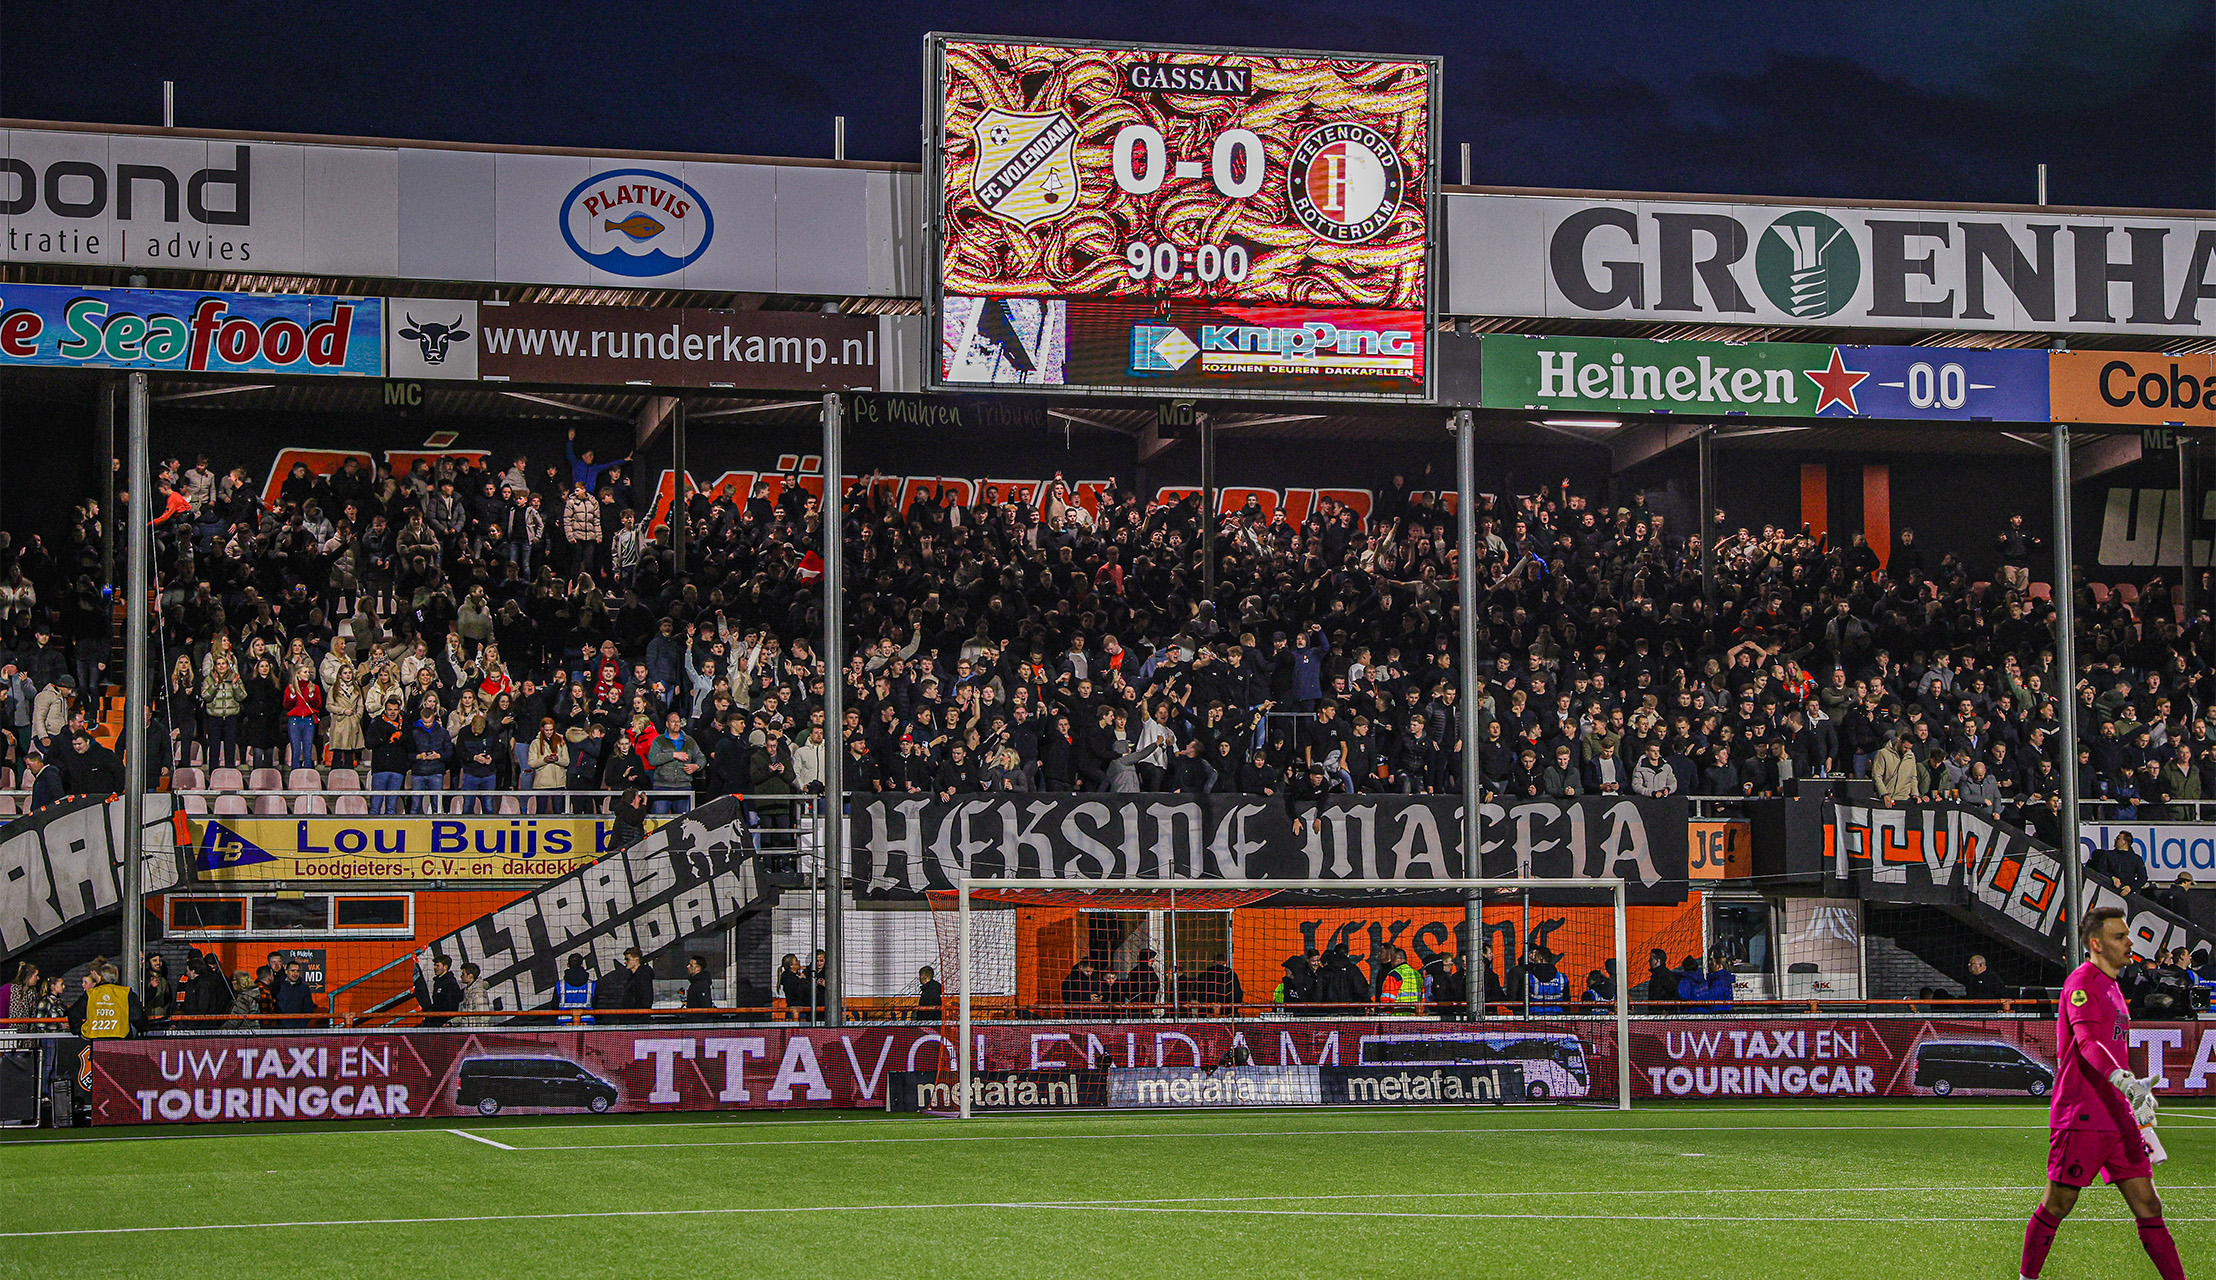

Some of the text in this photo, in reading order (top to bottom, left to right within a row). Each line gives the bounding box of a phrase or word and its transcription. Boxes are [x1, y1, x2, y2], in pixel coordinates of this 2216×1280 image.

[1131, 65, 1248, 92] GASSAN
[979, 118, 1073, 206] FC VOLENDAM
[1112, 125, 1265, 198] 0-0
[1297, 126, 1395, 167] FEYENOORD
[582, 184, 691, 219] PLATVIS
[1296, 197, 1396, 239] ROTTERDAM
[0, 227, 251, 261] tratie advies
[1127, 242, 1248, 283] 90:00
[0, 297, 355, 370] e Seafood
[483, 325, 874, 372] www.runderkamp.nl
[1201, 363, 1414, 378] KOZIJNEN DEUREN DAKKAPELLEN
[1537, 350, 1799, 405] Heineken
[1907, 361, 1968, 410] 0.0
[384, 383, 423, 406] MC
[854, 395, 1046, 429] Pé Mühren Tribune
[1160, 403, 1194, 426] MD
[2143, 428, 2174, 449] ME
[297, 819, 406, 854] Lou
[432, 819, 573, 859] Buijs
[865, 798, 1662, 894] HEKSIDE MAFFIA
[1834, 804, 1907, 884] FC
[423, 860, 466, 876] C.V.-
[472, 864, 493, 876] en
[418, 829, 677, 1004] ULTRAS
[305, 971, 323, 982] MD
[91, 1020, 118, 1030] 2227
[96, 1008, 115, 1017] FOTO
[1665, 1029, 1858, 1059] UW TAXI EN
[160, 1045, 390, 1082] UW TAXI EN
[633, 1035, 832, 1104] TTA
[1648, 1065, 1876, 1096] TOURINGCAR
[136, 1083, 411, 1120] TOURINGCAR
[917, 1073, 1078, 1108] metafa.nl
[1137, 1071, 1296, 1104] metafa.nl
[1347, 1068, 1501, 1101] metafa.nl
